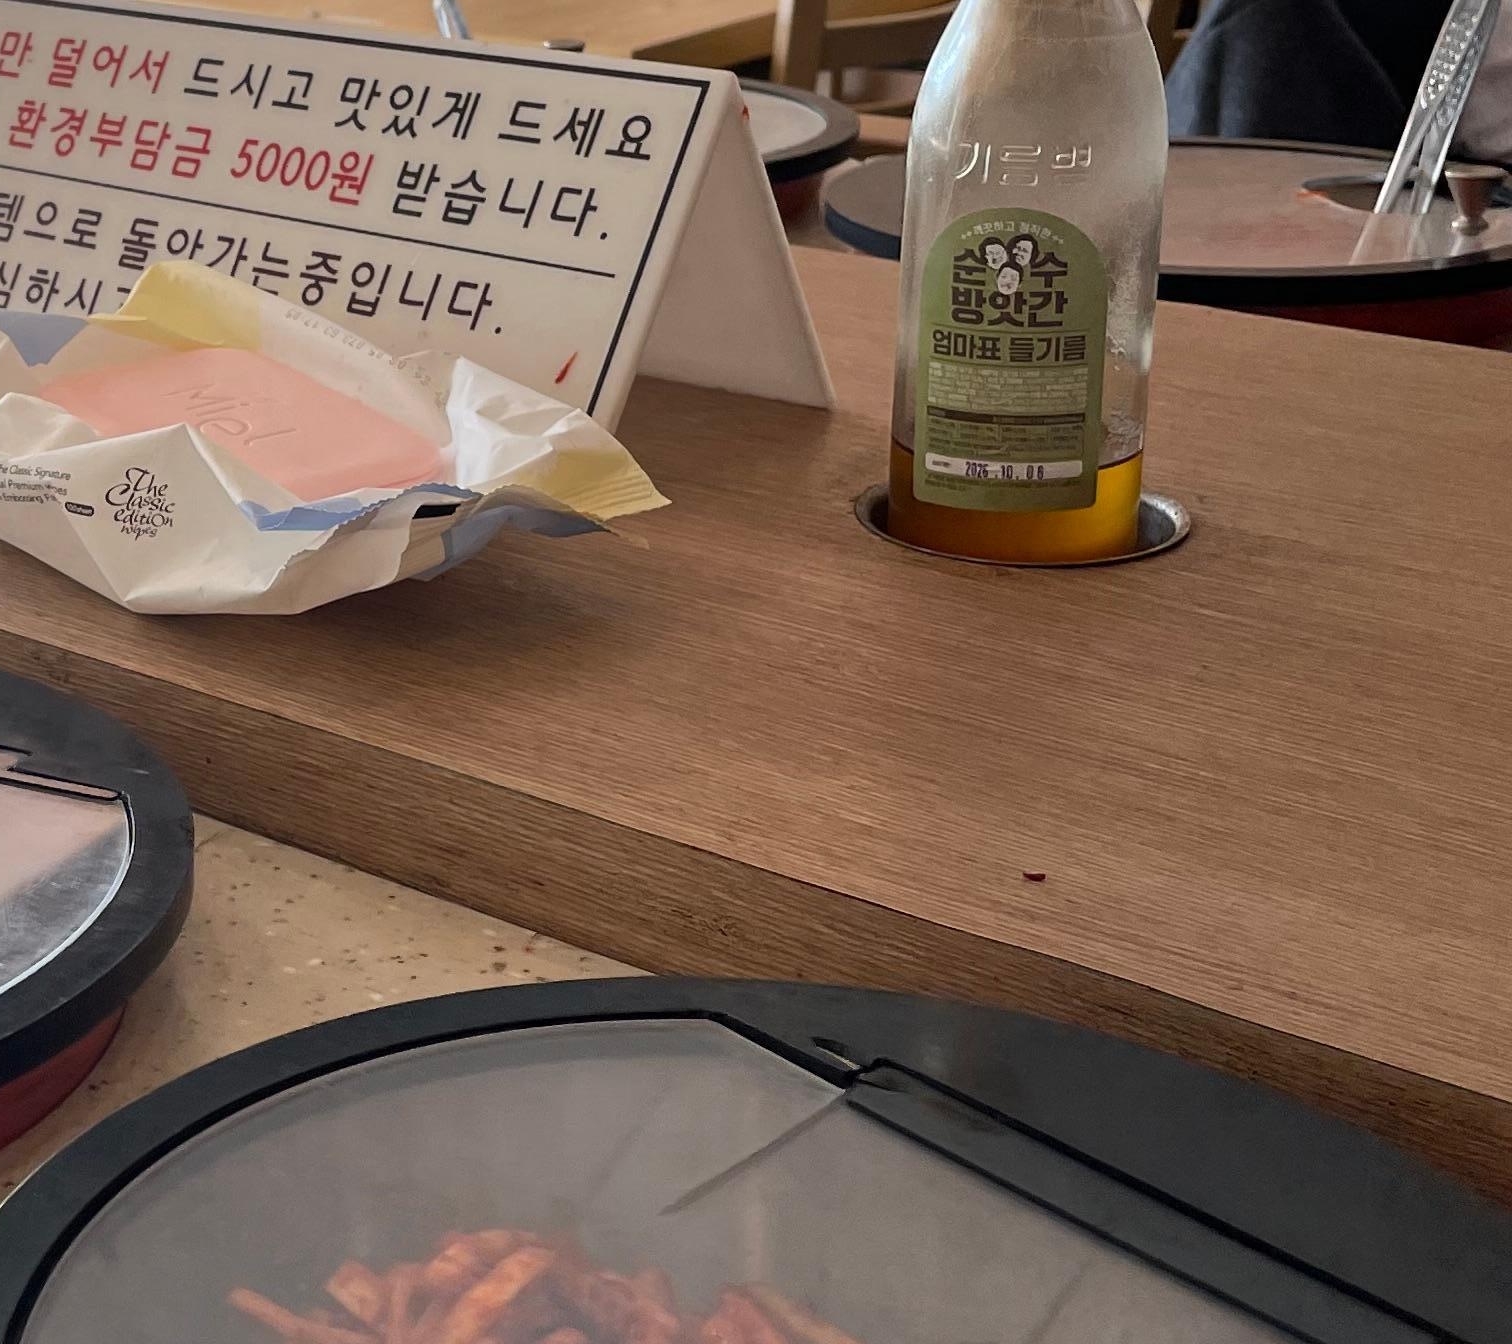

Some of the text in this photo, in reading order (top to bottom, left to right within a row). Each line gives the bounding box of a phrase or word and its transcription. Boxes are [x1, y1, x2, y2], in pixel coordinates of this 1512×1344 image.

[47, 37, 171, 94] 덜어서
[183, 58, 314, 111] 드시고
[334, 76, 482, 140] 맛있게
[497, 99, 654, 161] 드세요
[8, 98, 213, 180] 환경부담금
[230, 139, 375, 206] 5000원
[392, 160, 608, 241] 받습니다.
[117, 217, 503, 336] 돌아가는중입니다.
[951, 286, 1069, 328] 방앗간
[932, 328, 1087, 363] 엄마표 들기름
[8, 479, 45, 492] Premium
[105, 483, 176, 514] Classic
[125, 467, 169, 497] The
